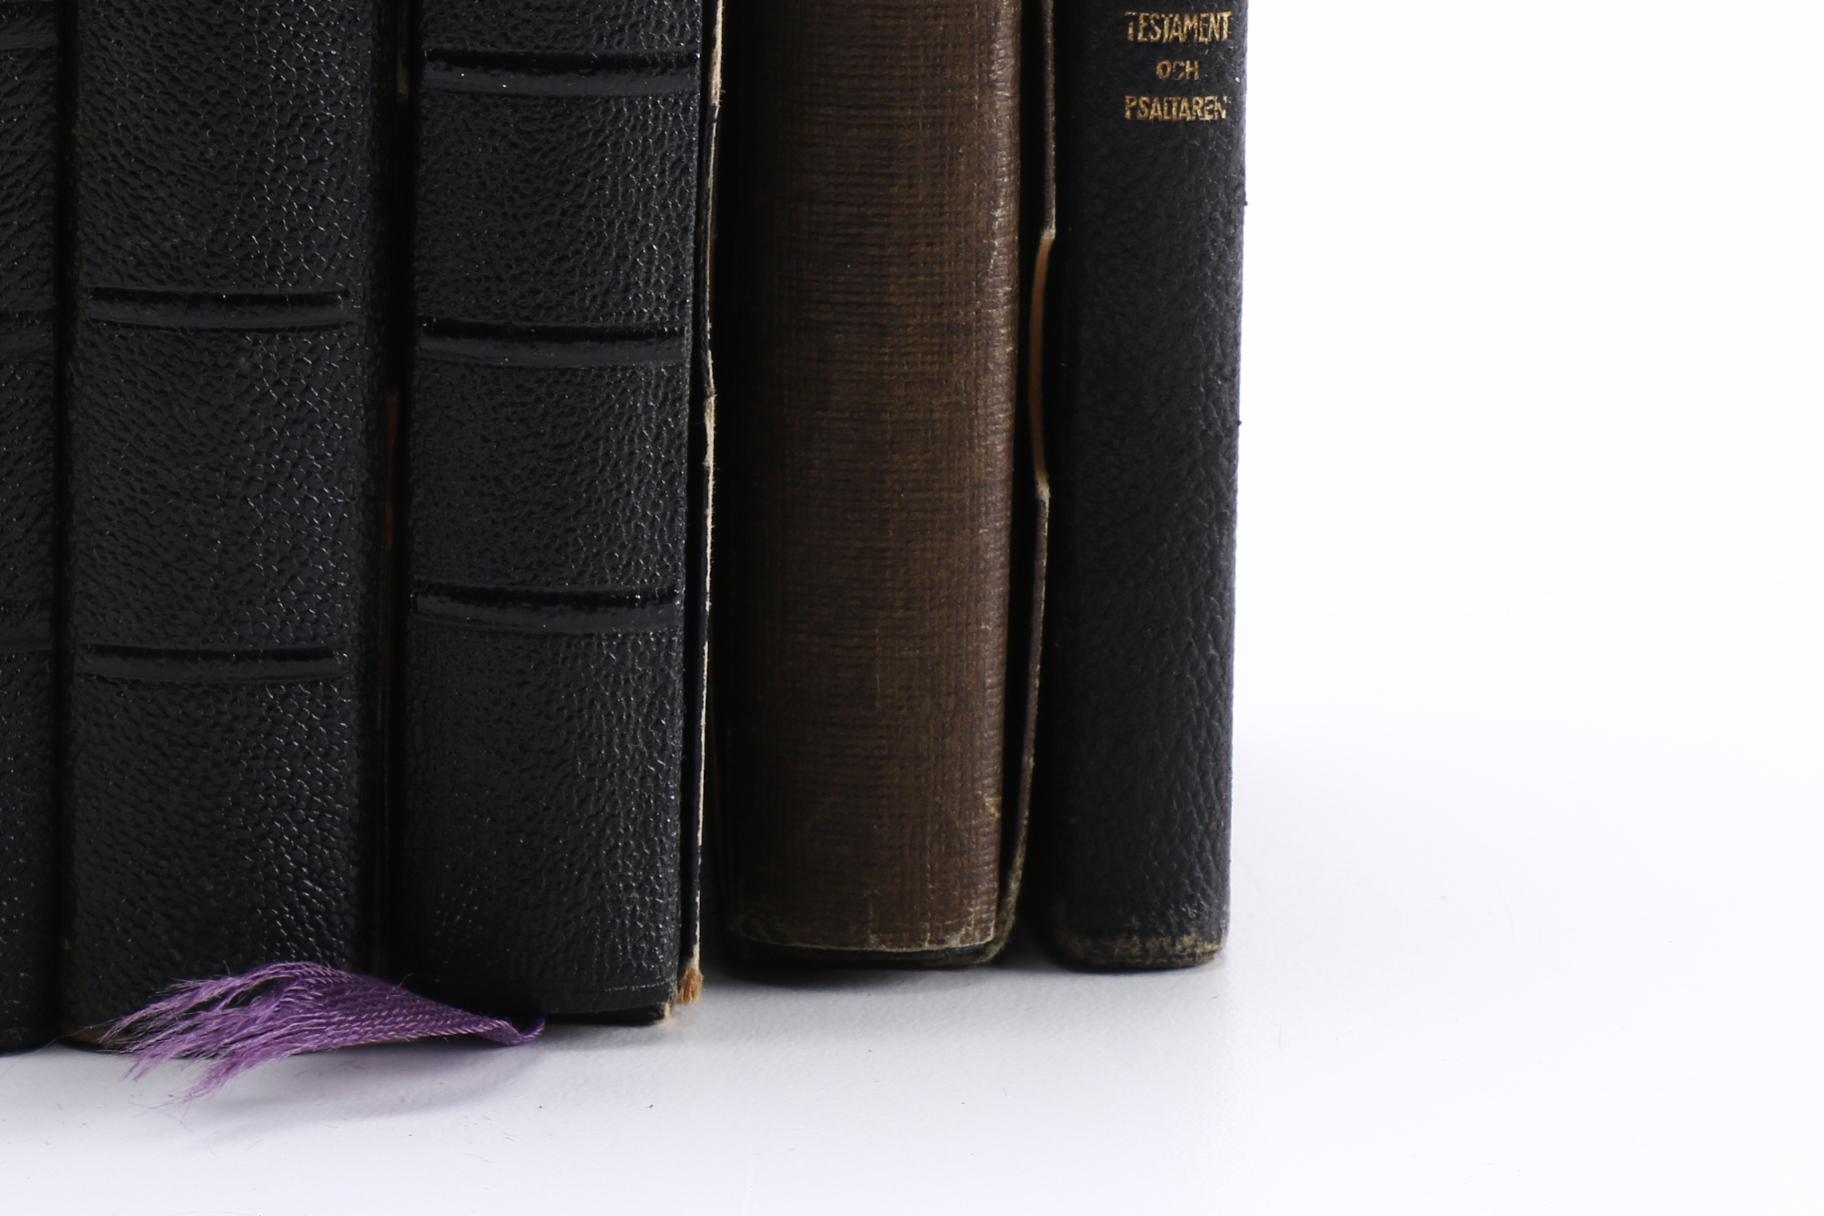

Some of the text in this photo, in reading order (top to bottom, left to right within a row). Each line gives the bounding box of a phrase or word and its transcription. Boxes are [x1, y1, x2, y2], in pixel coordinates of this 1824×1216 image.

[1125, 11, 1233, 44] TESTAMENT
[1156, 60, 1201, 81] OCH
[1125, 95, 1232, 121] PSALTAREN
